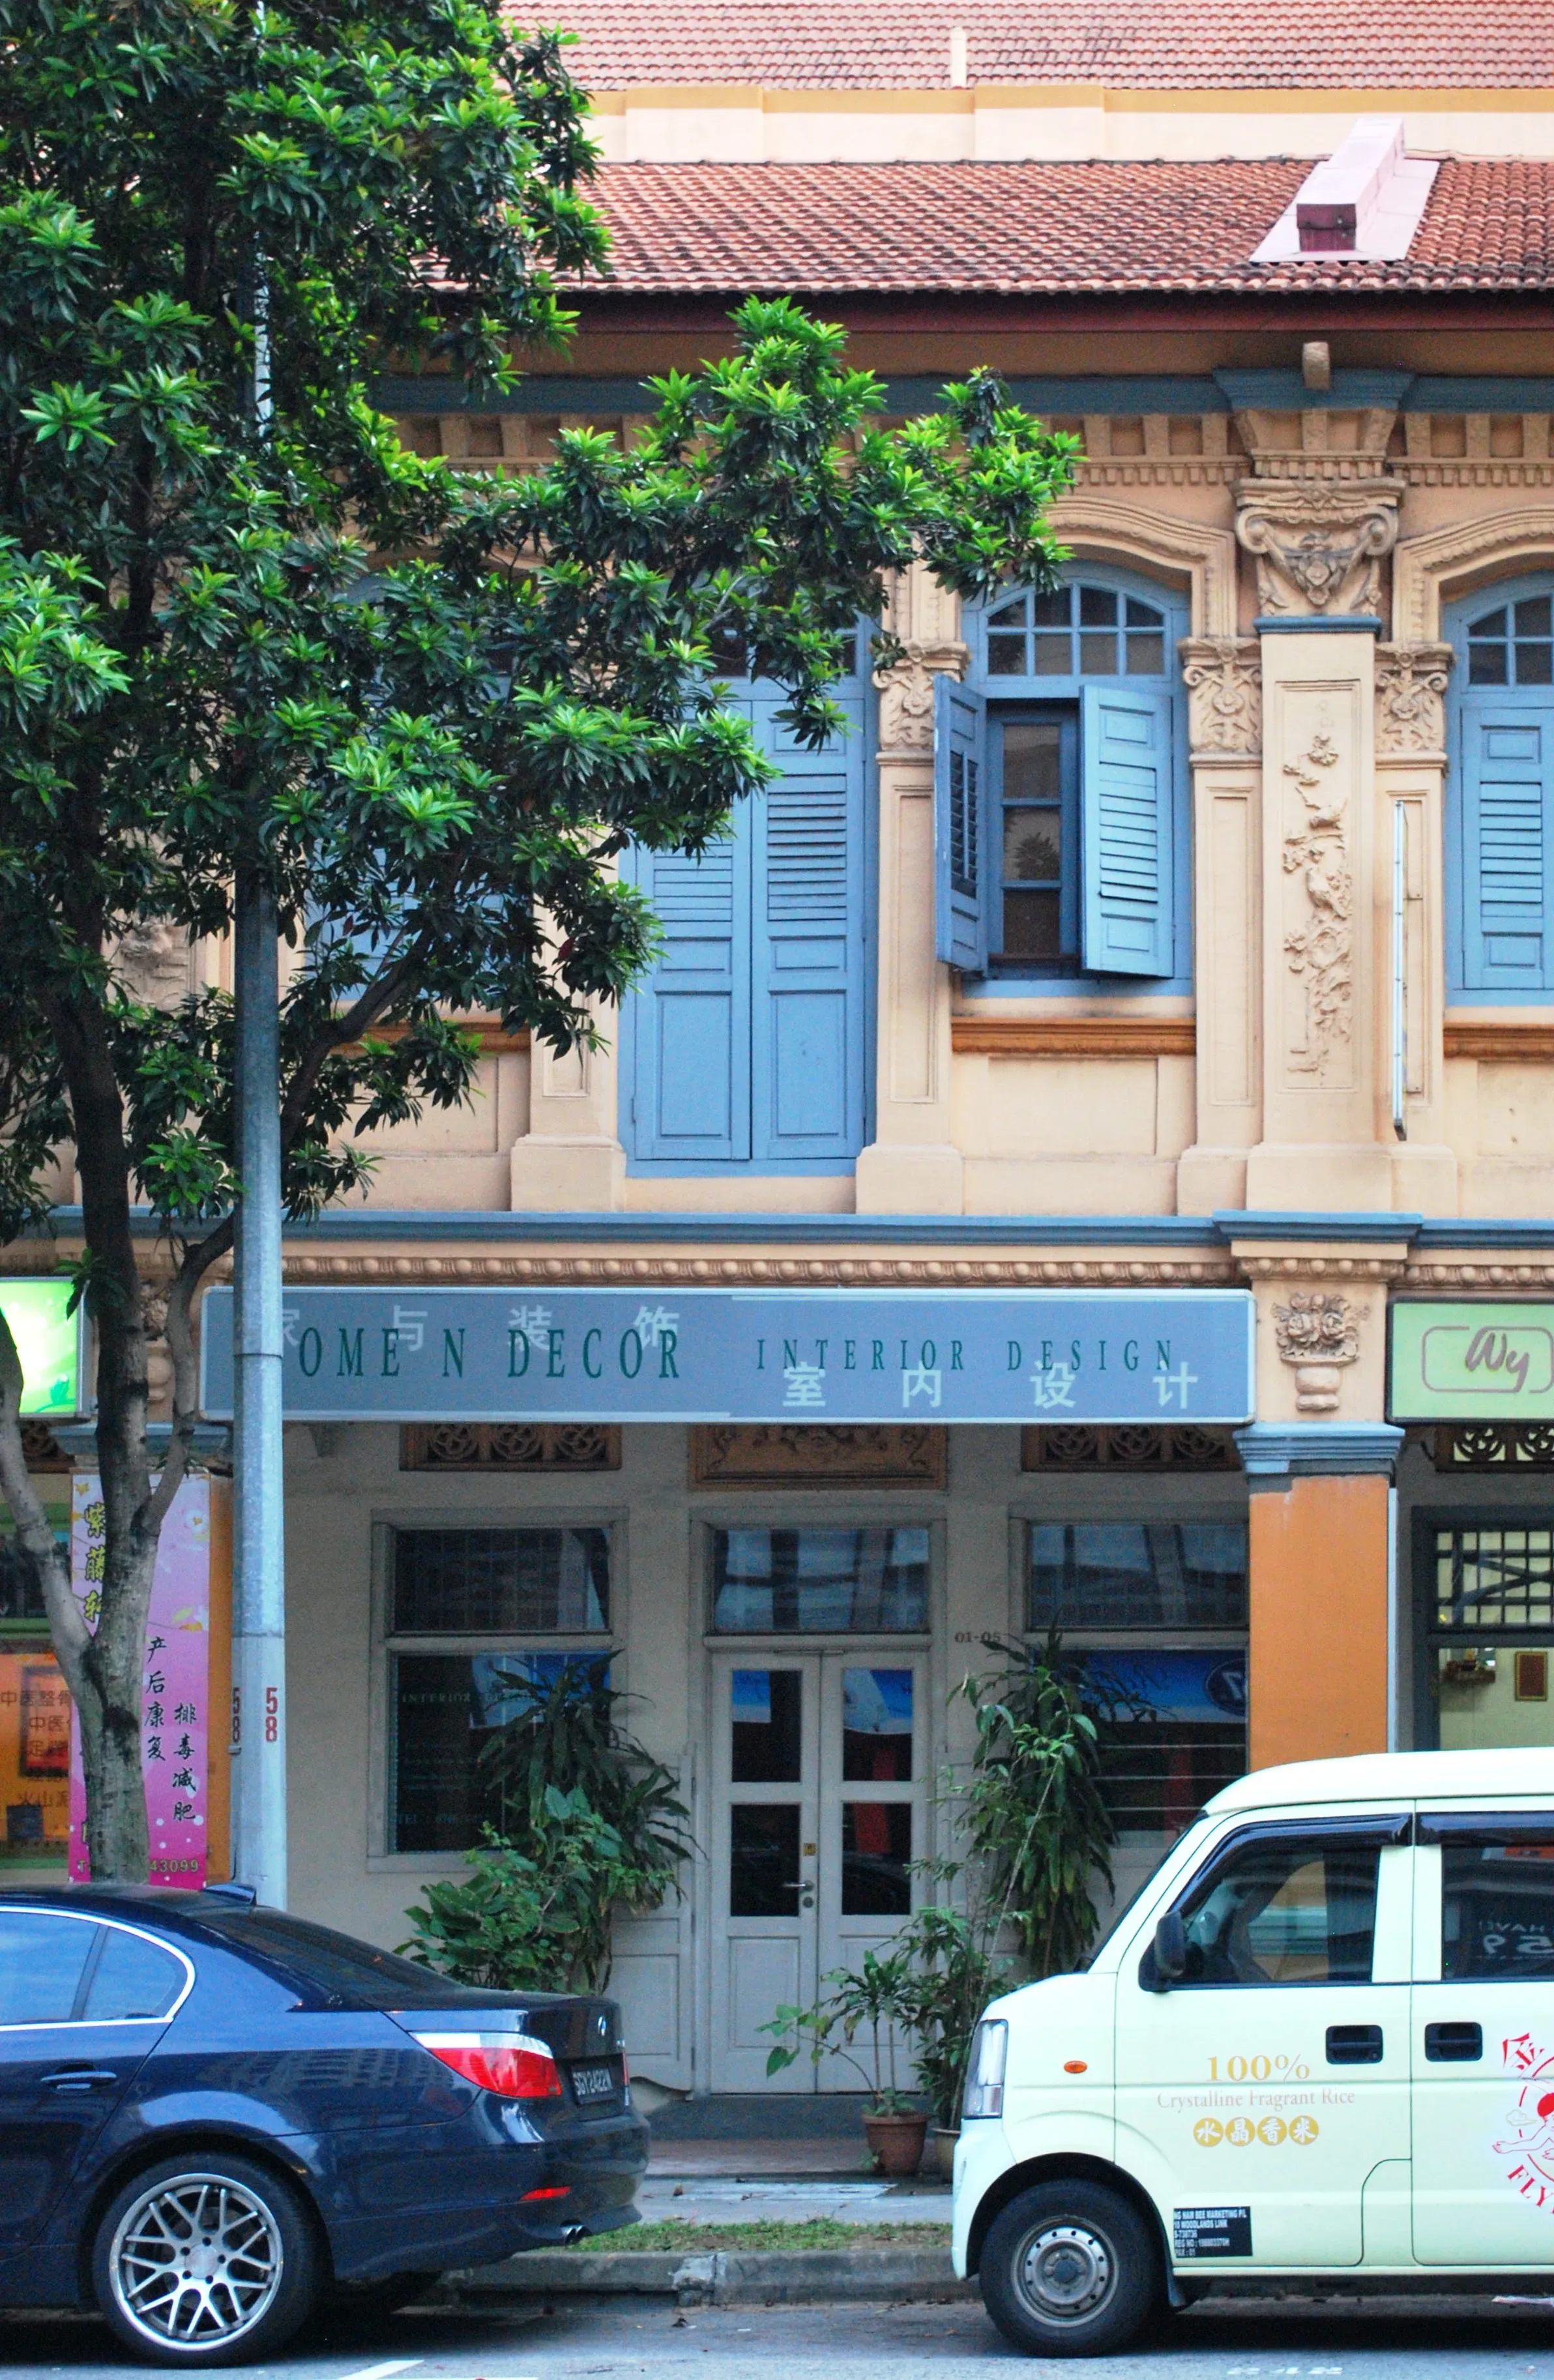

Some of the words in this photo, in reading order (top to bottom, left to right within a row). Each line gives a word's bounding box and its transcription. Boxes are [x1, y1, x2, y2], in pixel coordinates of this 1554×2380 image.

[299, 1327, 400, 1377] OME
[506, 1328, 680, 1379] DECOR
[757, 1339, 964, 1370] INTERIOR
[1007, 1340, 1171, 1371] DESIGN
[783, 1360, 1199, 1409] 室内设计
[144, 1636, 167, 1761] 产后康复
[29, 1714, 70, 1733] 中医
[265, 1687, 278, 1742] 58
[173, 1701, 197, 1822] 排毒减肥
[1206, 2054, 1310, 2083] 100%
[1157, 2089, 1244, 2114] Crystalline
[1249, 2088, 1316, 2113] Fragrant
[1322, 2087, 1356, 2106] Rice
[1194, 2116, 1318, 2146] 水晶香米
[1181, 2220, 1214, 2229] WOODLANDS
[1206, 2209, 1238, 2218] MARKETING
